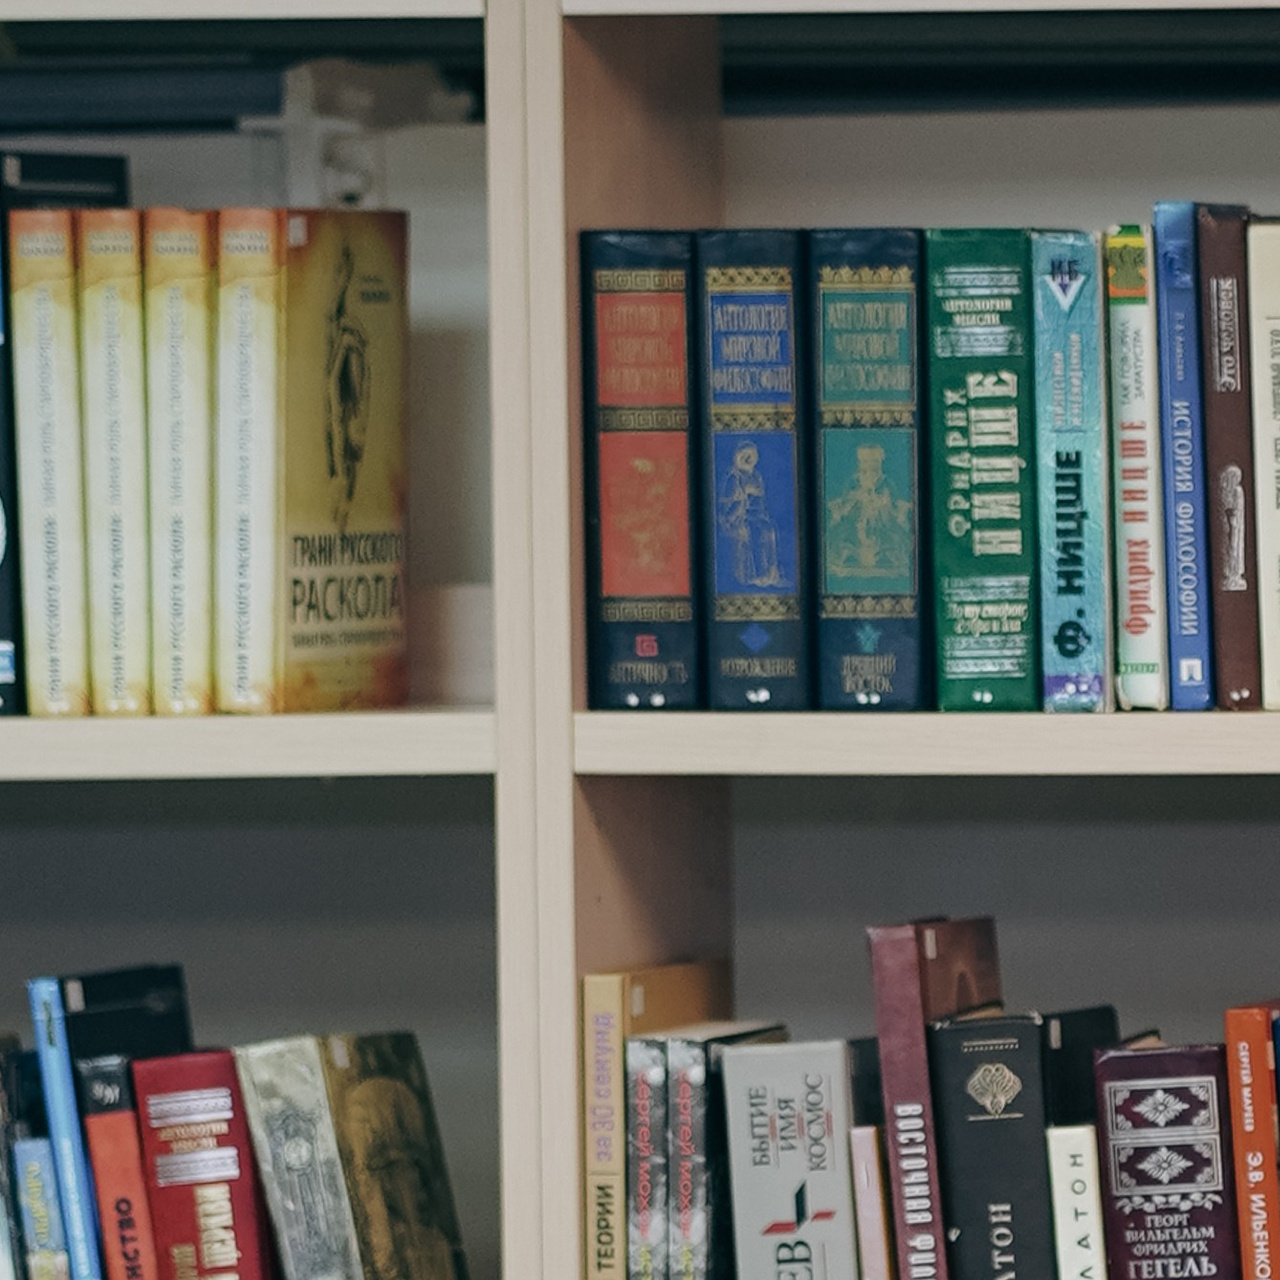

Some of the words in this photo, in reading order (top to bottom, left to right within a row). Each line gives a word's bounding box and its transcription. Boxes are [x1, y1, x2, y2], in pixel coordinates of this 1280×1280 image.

[944, 387, 971, 538] ФРИДРИХ
[966, 371, 1026, 557] НИЦШЕ
[1119, 420, 1149, 523] НИЦШЕ
[1172, 400, 1194, 493] ИСТОРИЯ
[1055, 449, 1088, 596] НИЦШЕ
[1122, 537, 1154, 636] Фридрих
[1176, 502, 1200, 635] ФИЛОСОФИИ
[1052, 607, 1091, 659] Ф.
[636, 1070, 654, 1154] сергей
[676, 1070, 694, 1154] сергей
[749, 1085, 771, 1168] БЫТИЕ
[777, 1097, 798, 1152] ИМЯ
[804, 1073, 828, 1173] КОСМОС
[893, 1102, 933, 1225] ВОСТОЧНАЯ
[1246, 1151, 1266, 1187] Э.В.
[595, 1184, 616, 1269] ТЕОРИИ
[1125, 1226, 1215, 1243] ВИЛЬГЕЛЬМ
[1133, 1240, 1208, 1257] ФРИДРИХ
[1145, 1214, 1191, 1229] ГЕОРГ
[1128, 1255, 1218, 1280] ГЕГЕЛЬ
